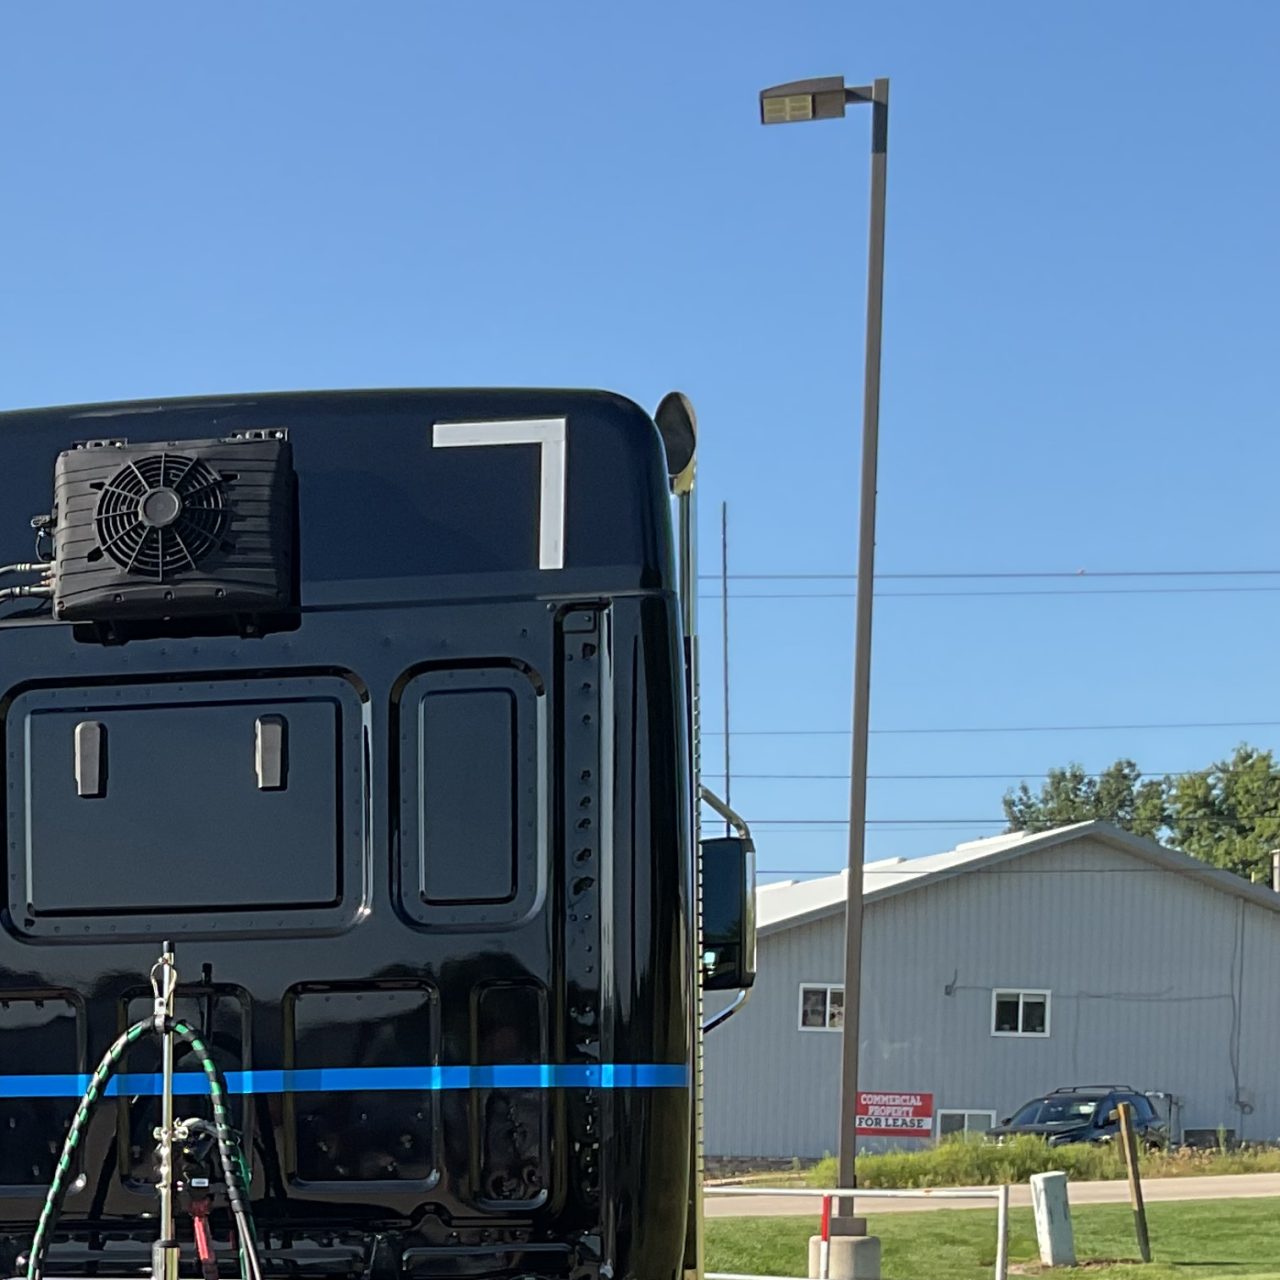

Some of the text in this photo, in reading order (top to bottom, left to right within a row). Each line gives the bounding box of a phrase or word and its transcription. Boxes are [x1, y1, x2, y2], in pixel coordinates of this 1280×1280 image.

[860, 1094, 922, 1106] COMMERCIAL
[867, 1106, 914, 1117] PROPERTY
[857, 1117, 924, 1128] FOR LEASE
